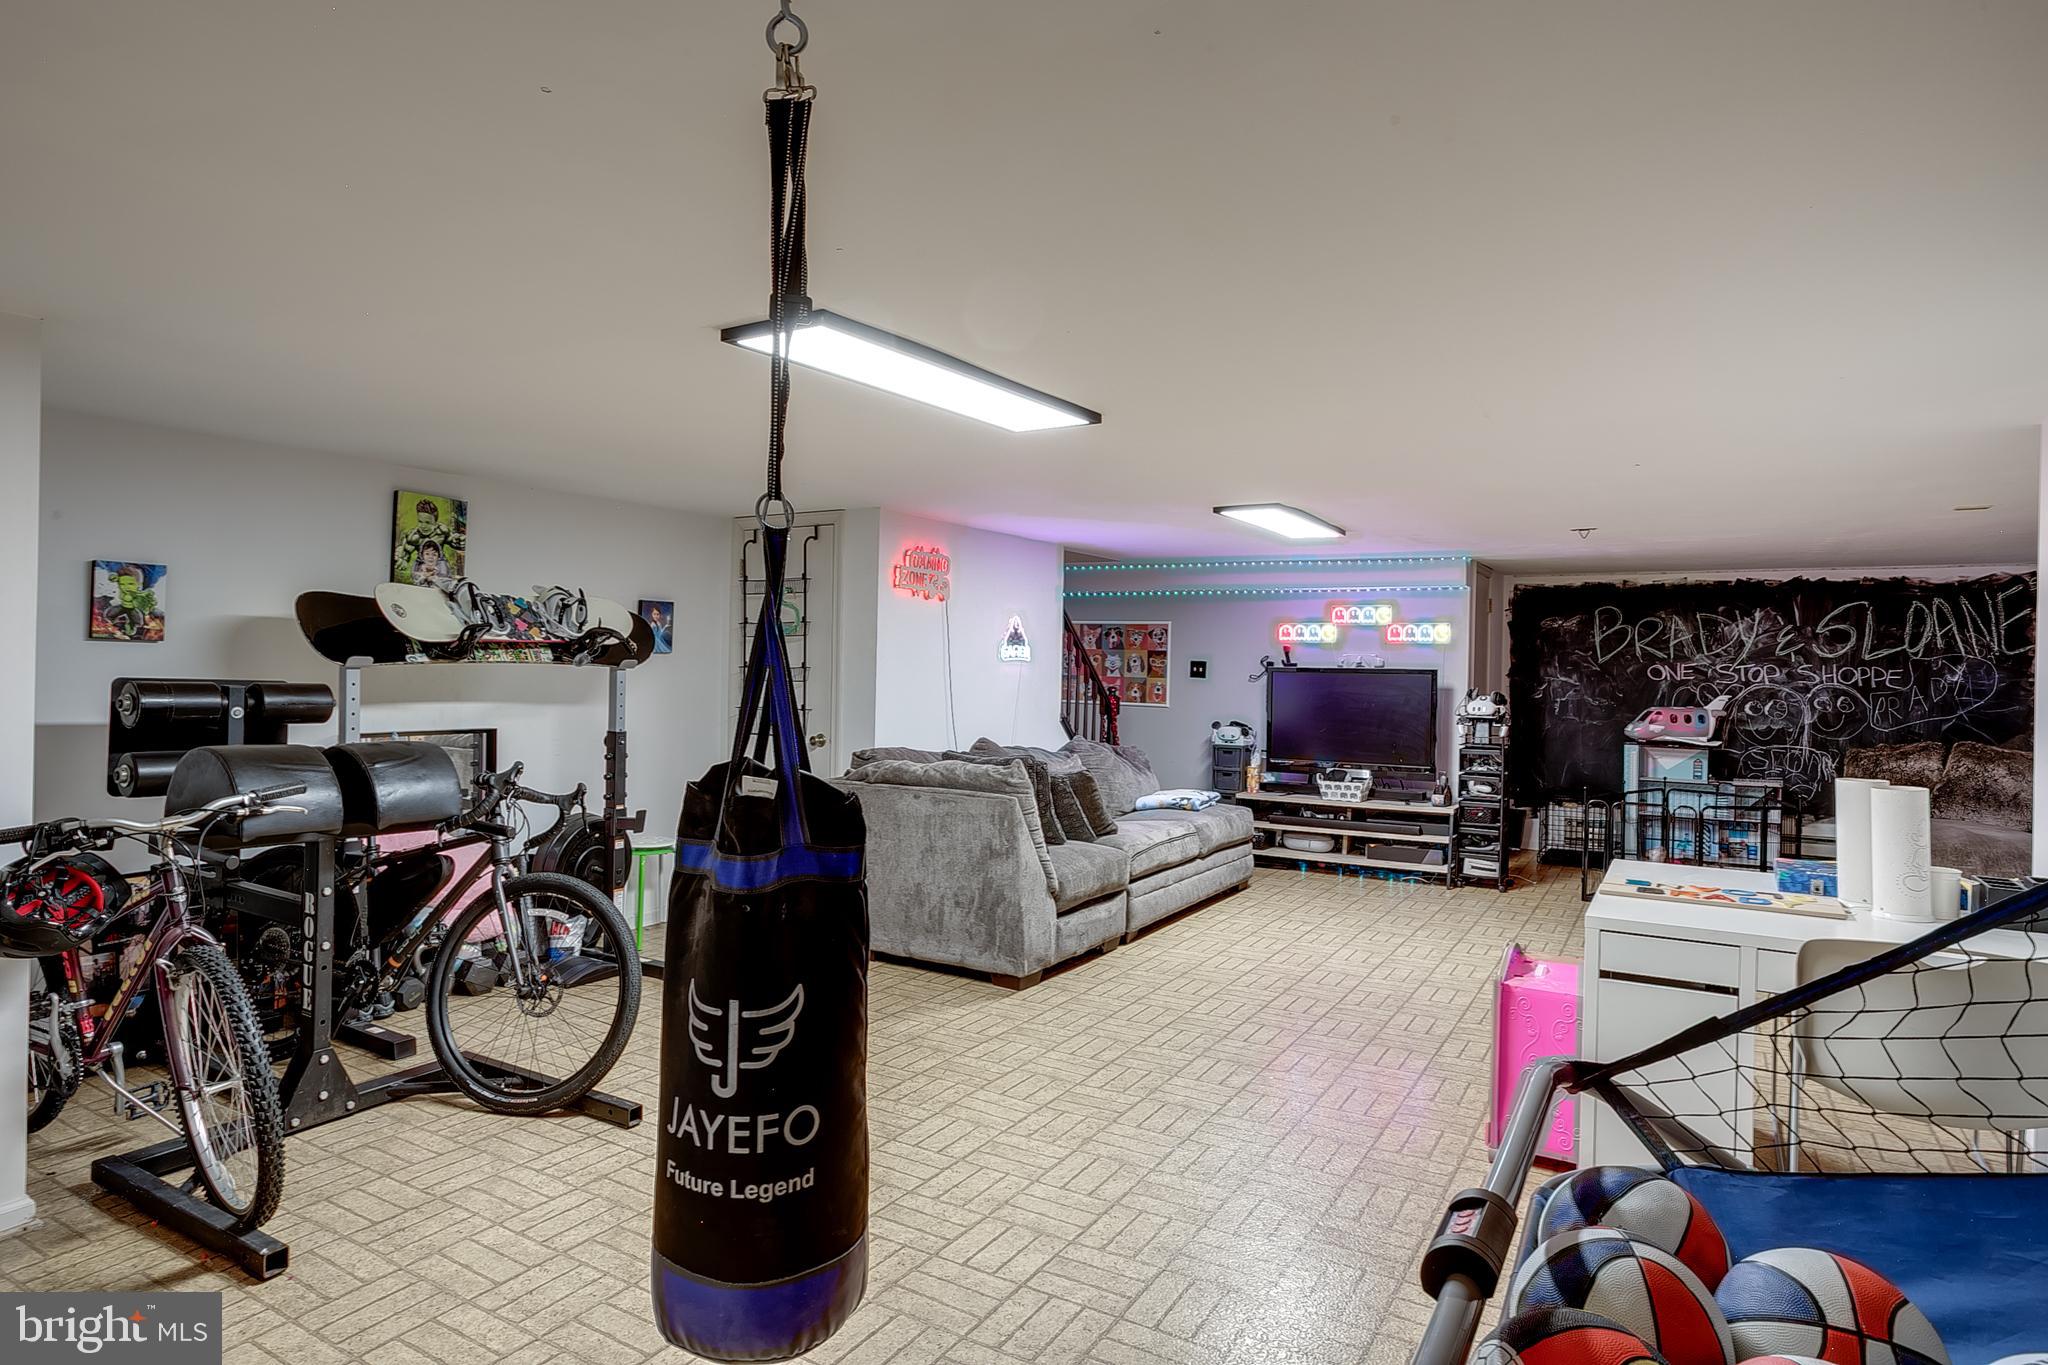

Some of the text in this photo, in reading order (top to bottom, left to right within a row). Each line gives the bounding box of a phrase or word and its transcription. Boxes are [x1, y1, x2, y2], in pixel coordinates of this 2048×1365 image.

[900, 569, 928, 588] ZONE
[1595, 605, 1760, 672] BRADY
[1812, 584, 2036, 660] SLOANE
[1646, 662, 1904, 690] ONE STOP SHOPPE
[1873, 659, 1968, 727] BRADY
[302, 891, 316, 1011] ROGUE
[666, 1096, 820, 1154] JAYEFO
[665, 1159, 815, 1203] Future Legend
